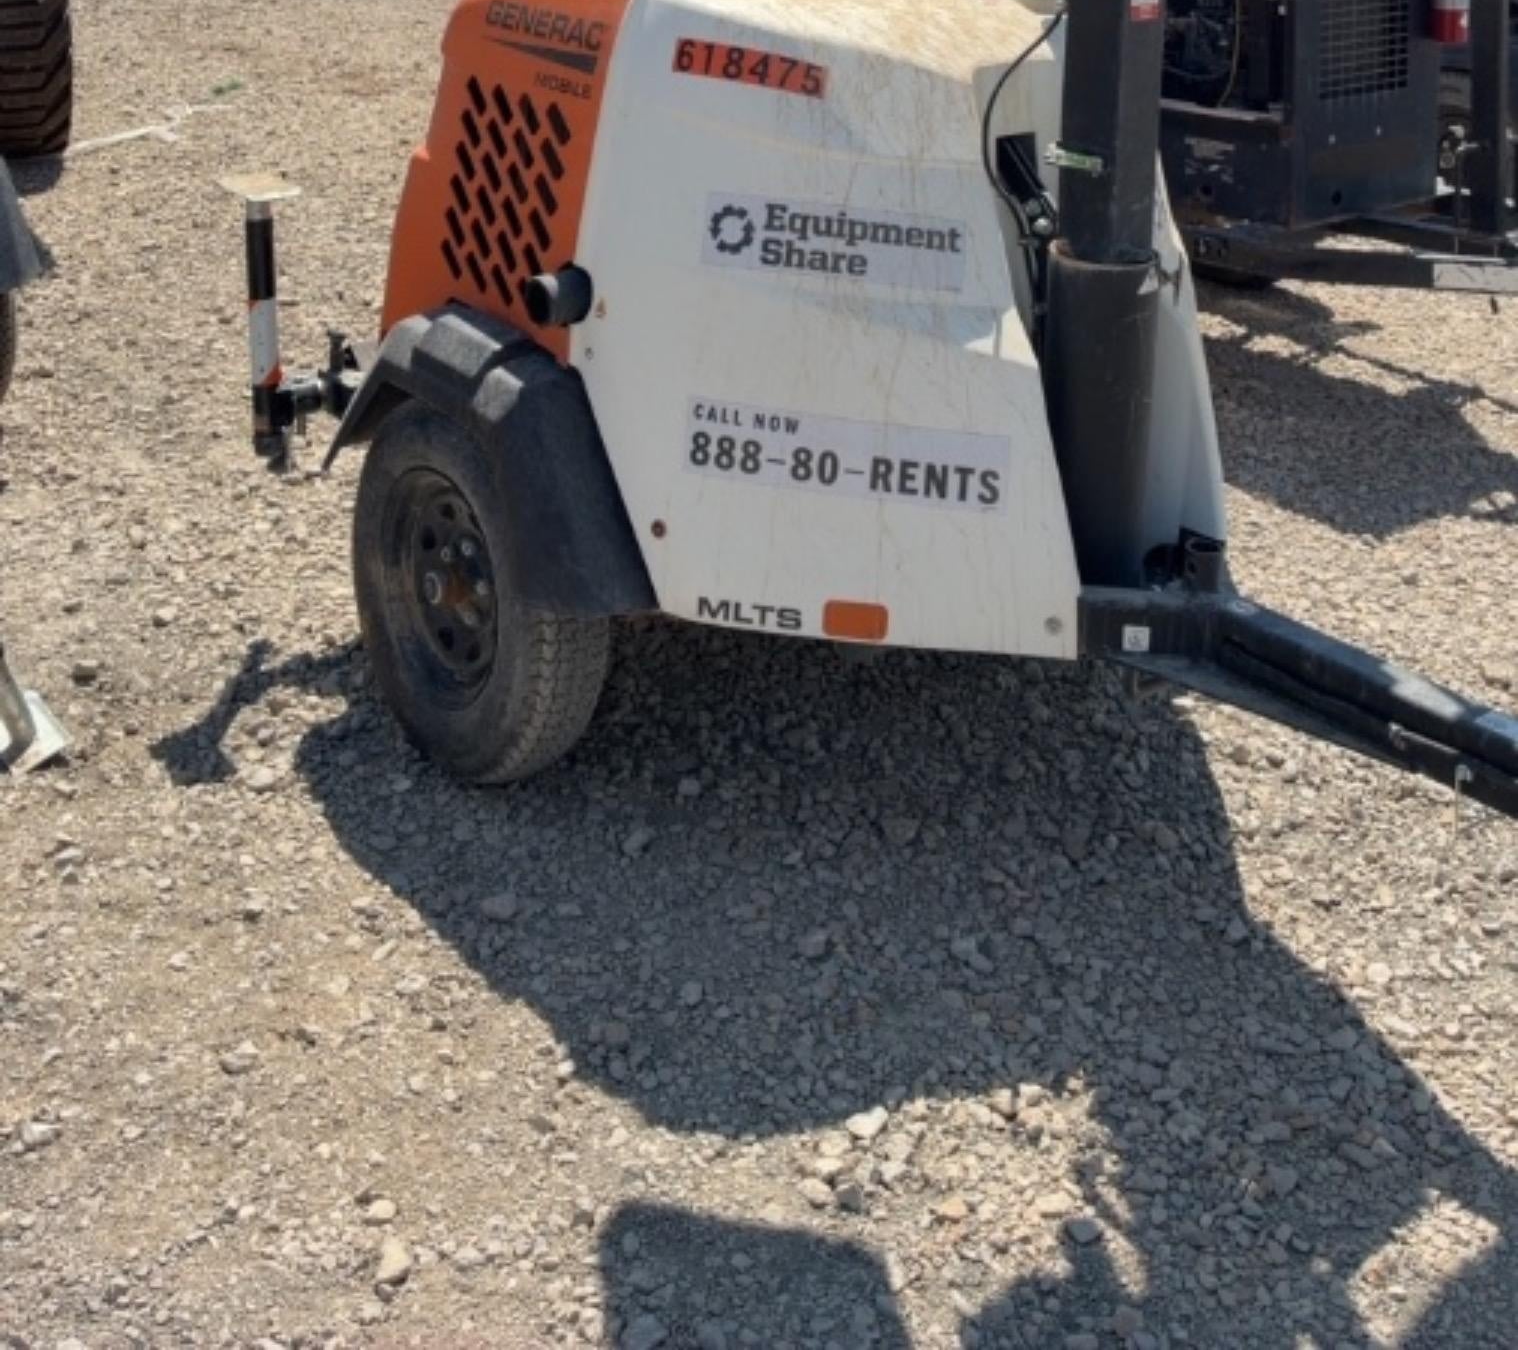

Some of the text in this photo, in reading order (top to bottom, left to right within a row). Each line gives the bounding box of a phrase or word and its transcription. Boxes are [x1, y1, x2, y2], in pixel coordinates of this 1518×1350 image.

[533, 71, 593, 99] MOBILE
[677, 38, 823, 97] 618475
[764, 203, 961, 252] Equipment
[760, 237, 867, 276] Share
[693, 404, 800, 434] CALL NOW
[690, 431, 1000, 505] 888-80-RENTS
[698, 596, 802, 630] MLTS
